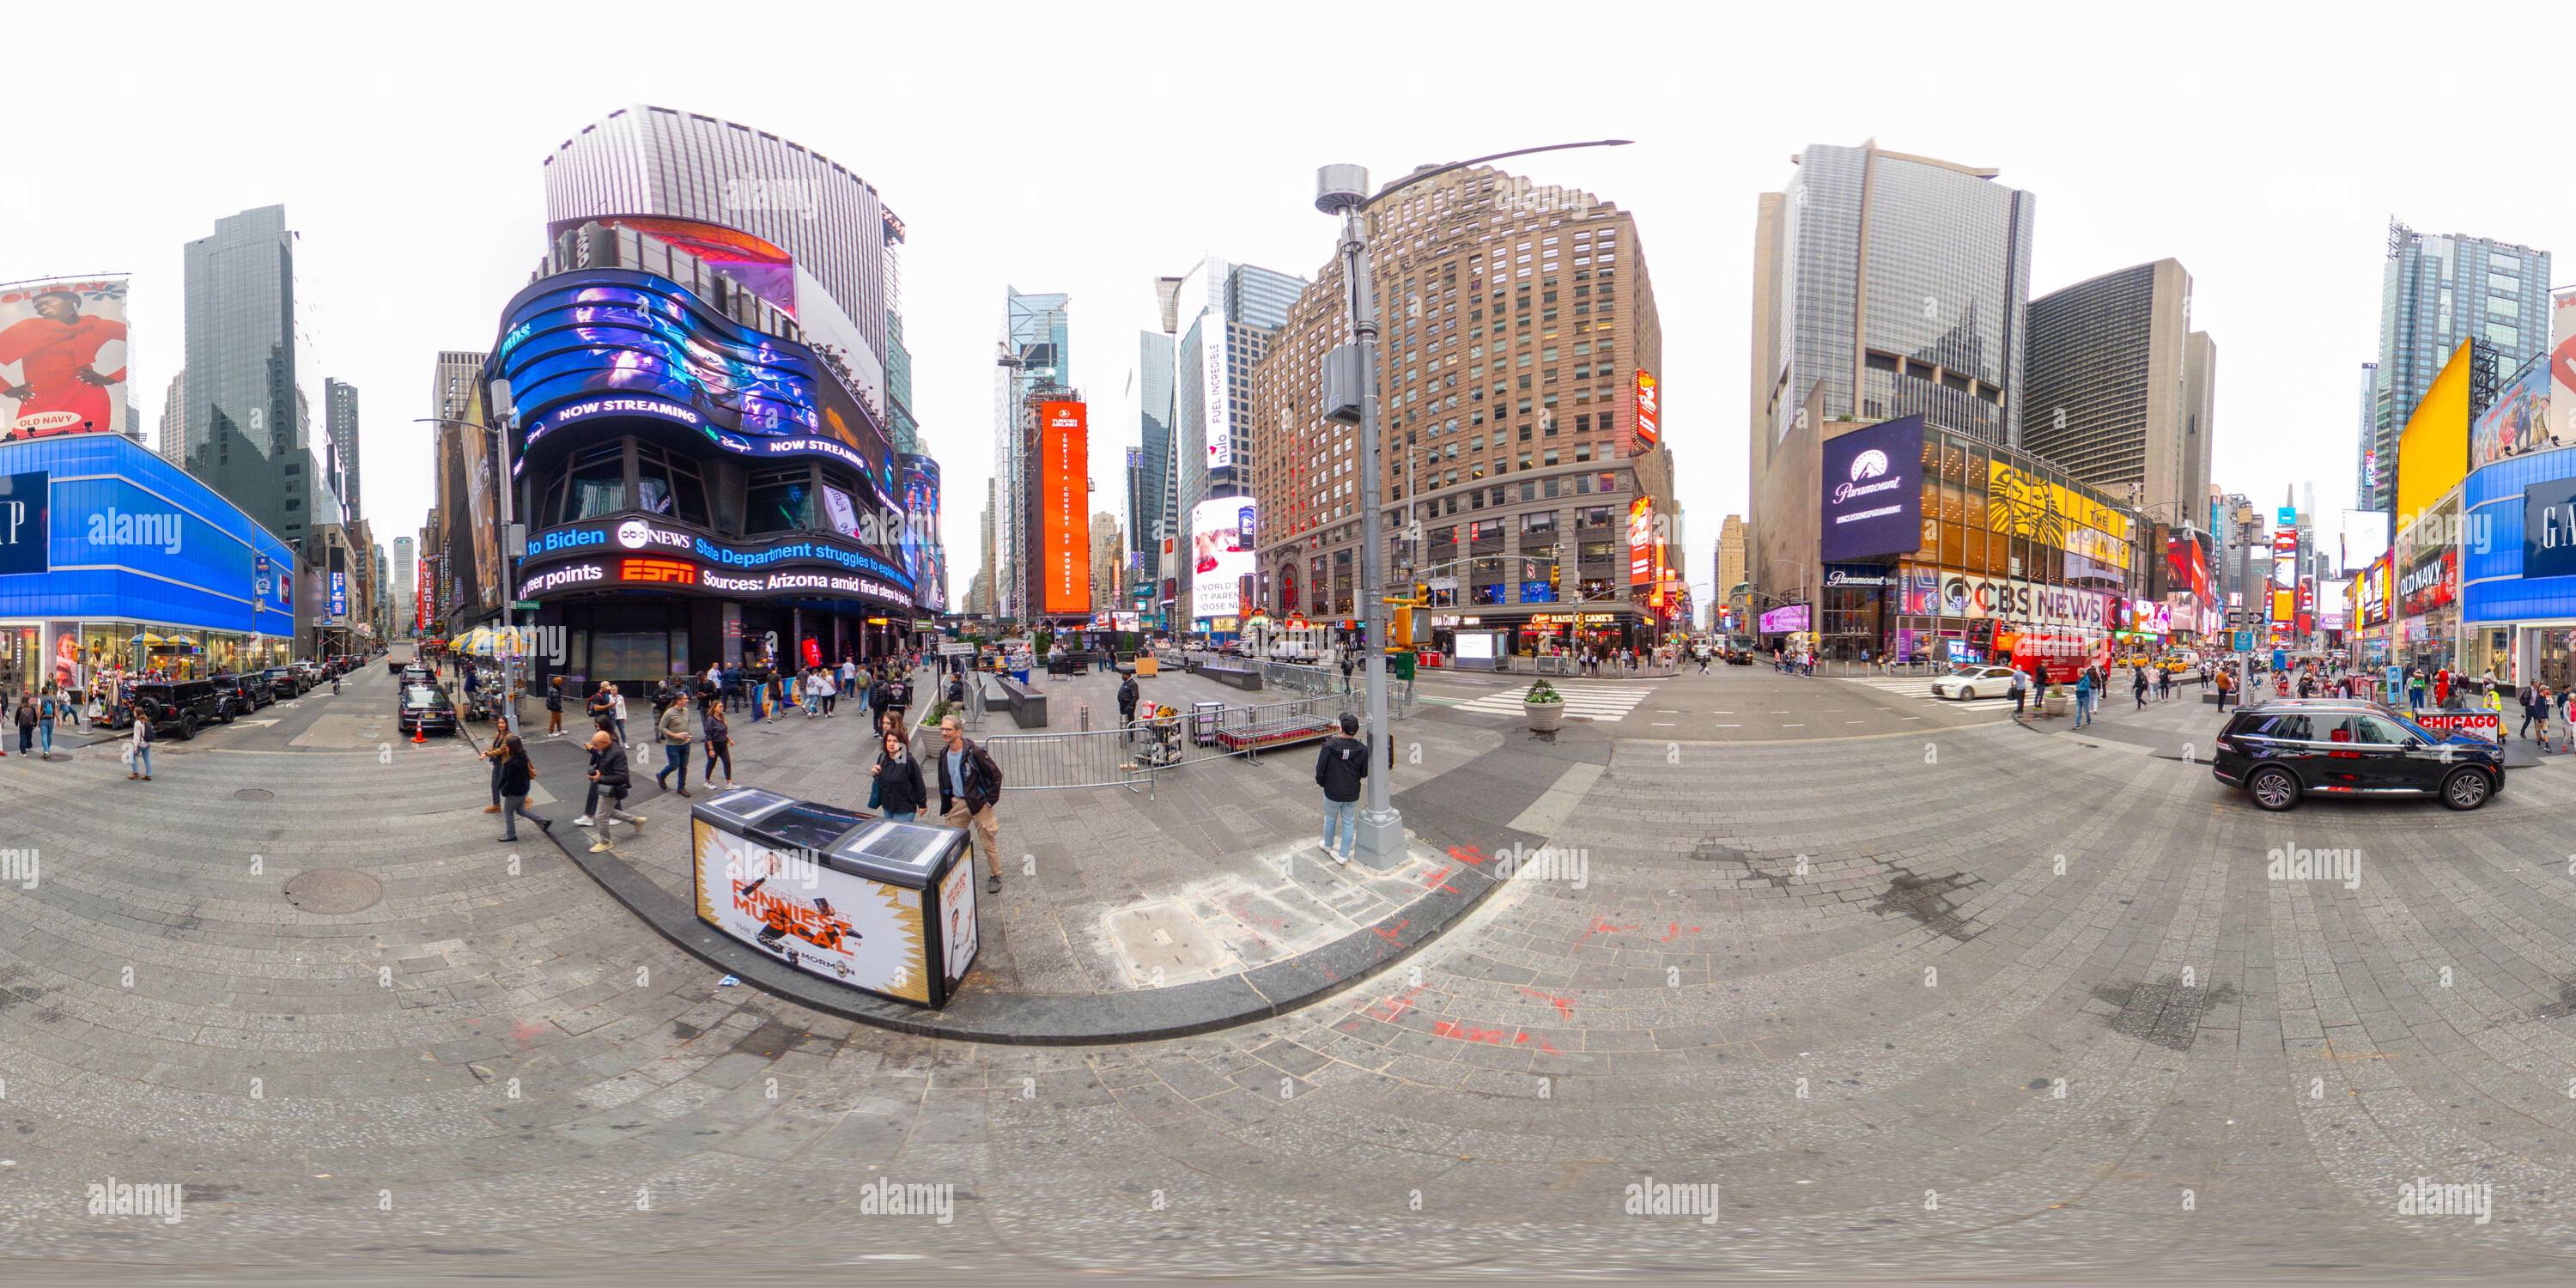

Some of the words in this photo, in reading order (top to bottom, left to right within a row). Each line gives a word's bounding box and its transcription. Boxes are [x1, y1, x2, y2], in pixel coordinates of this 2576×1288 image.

[1210, 344, 1220, 397] INCREDIBLE
[20, 418, 39, 427] OLD
[43, 415, 72, 424] NAVY
[560, 402, 599, 422] NOW
[605, 399, 697, 423] STREAMING
[1212, 398, 1221, 423] FUEL
[771, 440, 804, 452] NOW
[809, 440, 864, 468] STREAMING
[1216, 434, 1228, 464] nulo
[1832, 476, 1901, 504] Paramount
[2091, 512, 2107, 526] THE
[529, 540, 541, 556] to
[546, 529, 605, 550] Biden
[648, 530, 690, 548] NEWS
[696, 538, 719, 561] State
[722, 543, 811, 567] Department
[816, 545, 868, 567] struggles
[870, 558, 878, 570] to
[547, 564, 603, 589] points
[623, 559, 695, 584] ESPN
[703, 570, 762, 591] Sources:
[768, 572, 828, 590] Arizona
[831, 577, 859, 591] amid
[860, 580, 878, 595] final
[879, 586, 894, 600] steps
[1827, 570, 1884, 586] Paramount
[2401, 574, 2415, 596] OLD
[2415, 559, 2441, 590] NAVY
[1975, 582, 2032, 616] CBS
[2038, 590, 2100, 623] NEWS
[2419, 715, 2497, 729] CHICAGO
[732, 878, 853, 937] FUNNIEST
